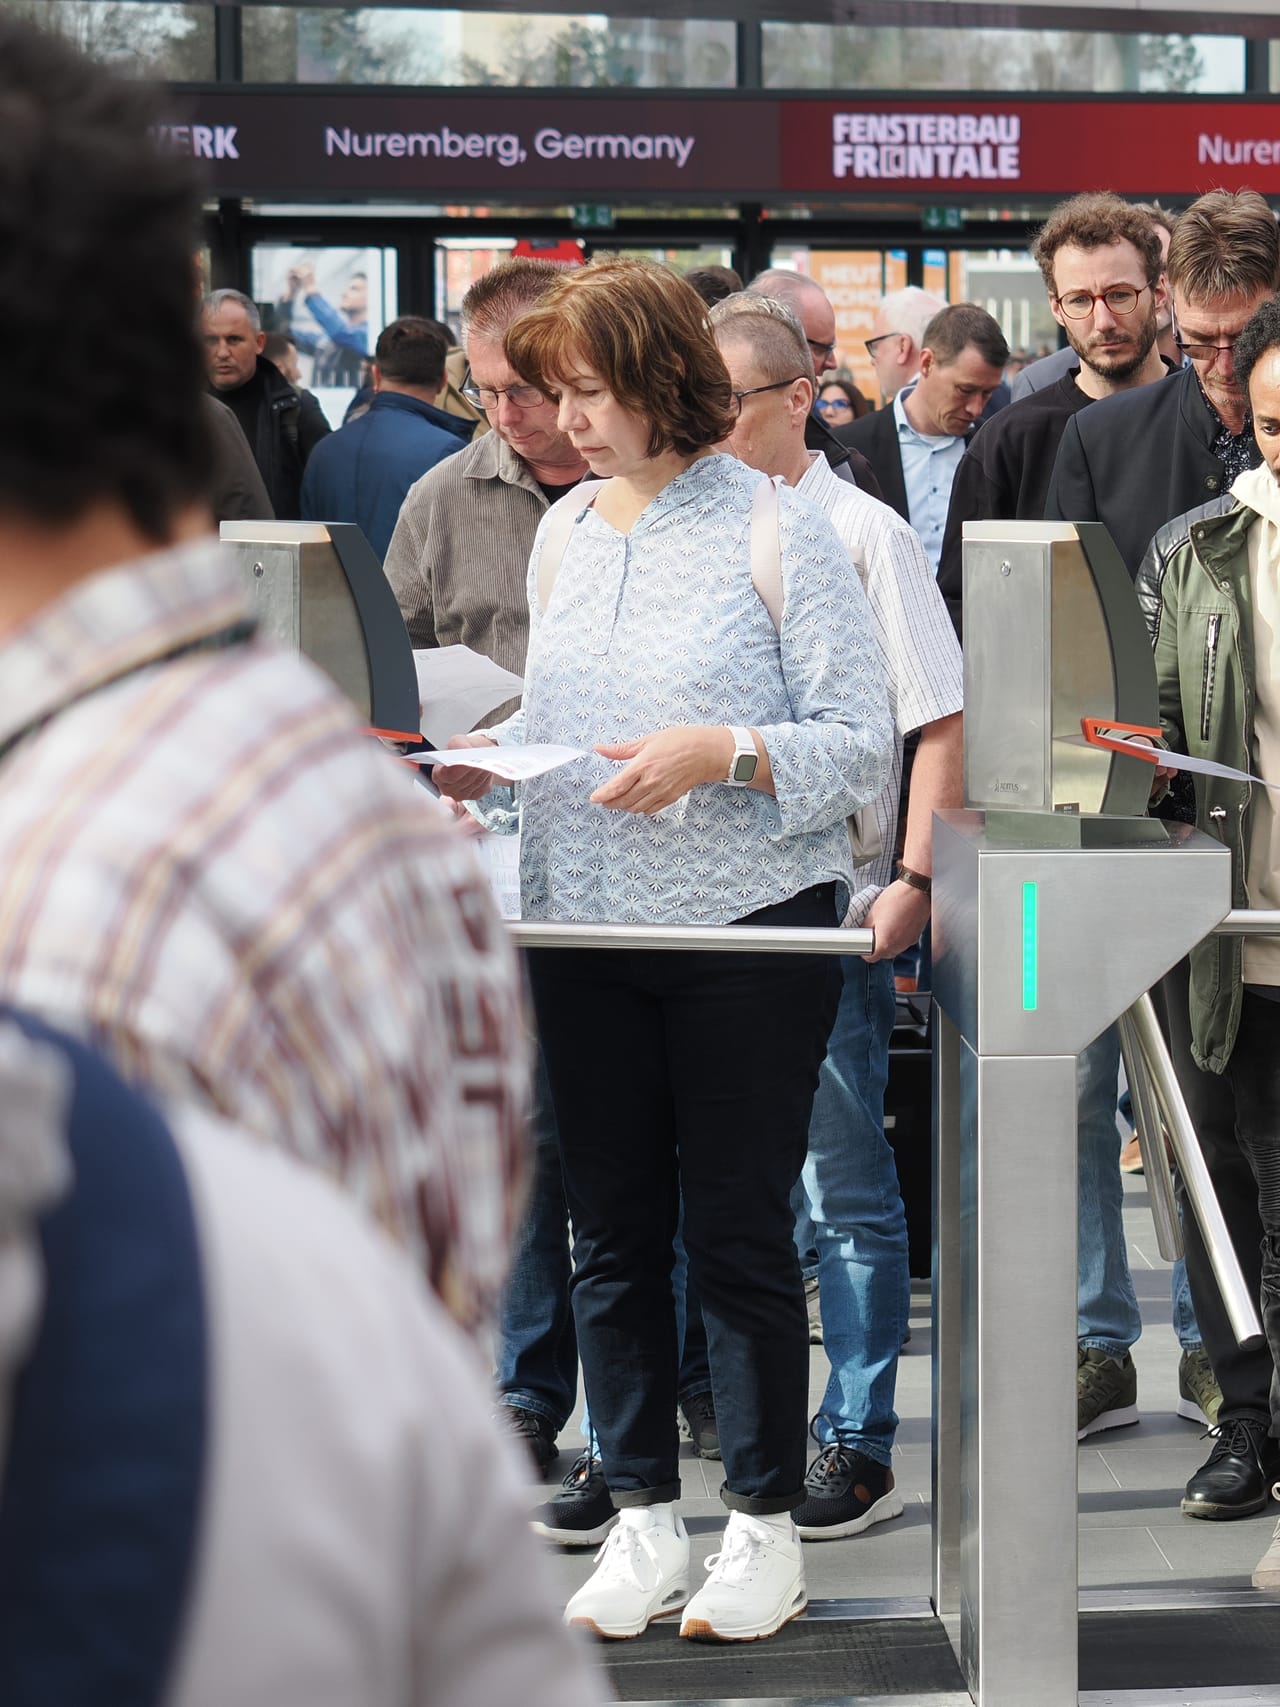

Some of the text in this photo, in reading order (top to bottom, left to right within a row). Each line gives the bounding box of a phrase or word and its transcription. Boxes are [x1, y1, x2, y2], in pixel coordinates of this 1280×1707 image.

[833, 114, 1020, 144] FENSTERBAU
[325, 127, 695, 168] Nuremberg, Germany
[833, 145, 1020, 179] FRONTALE
